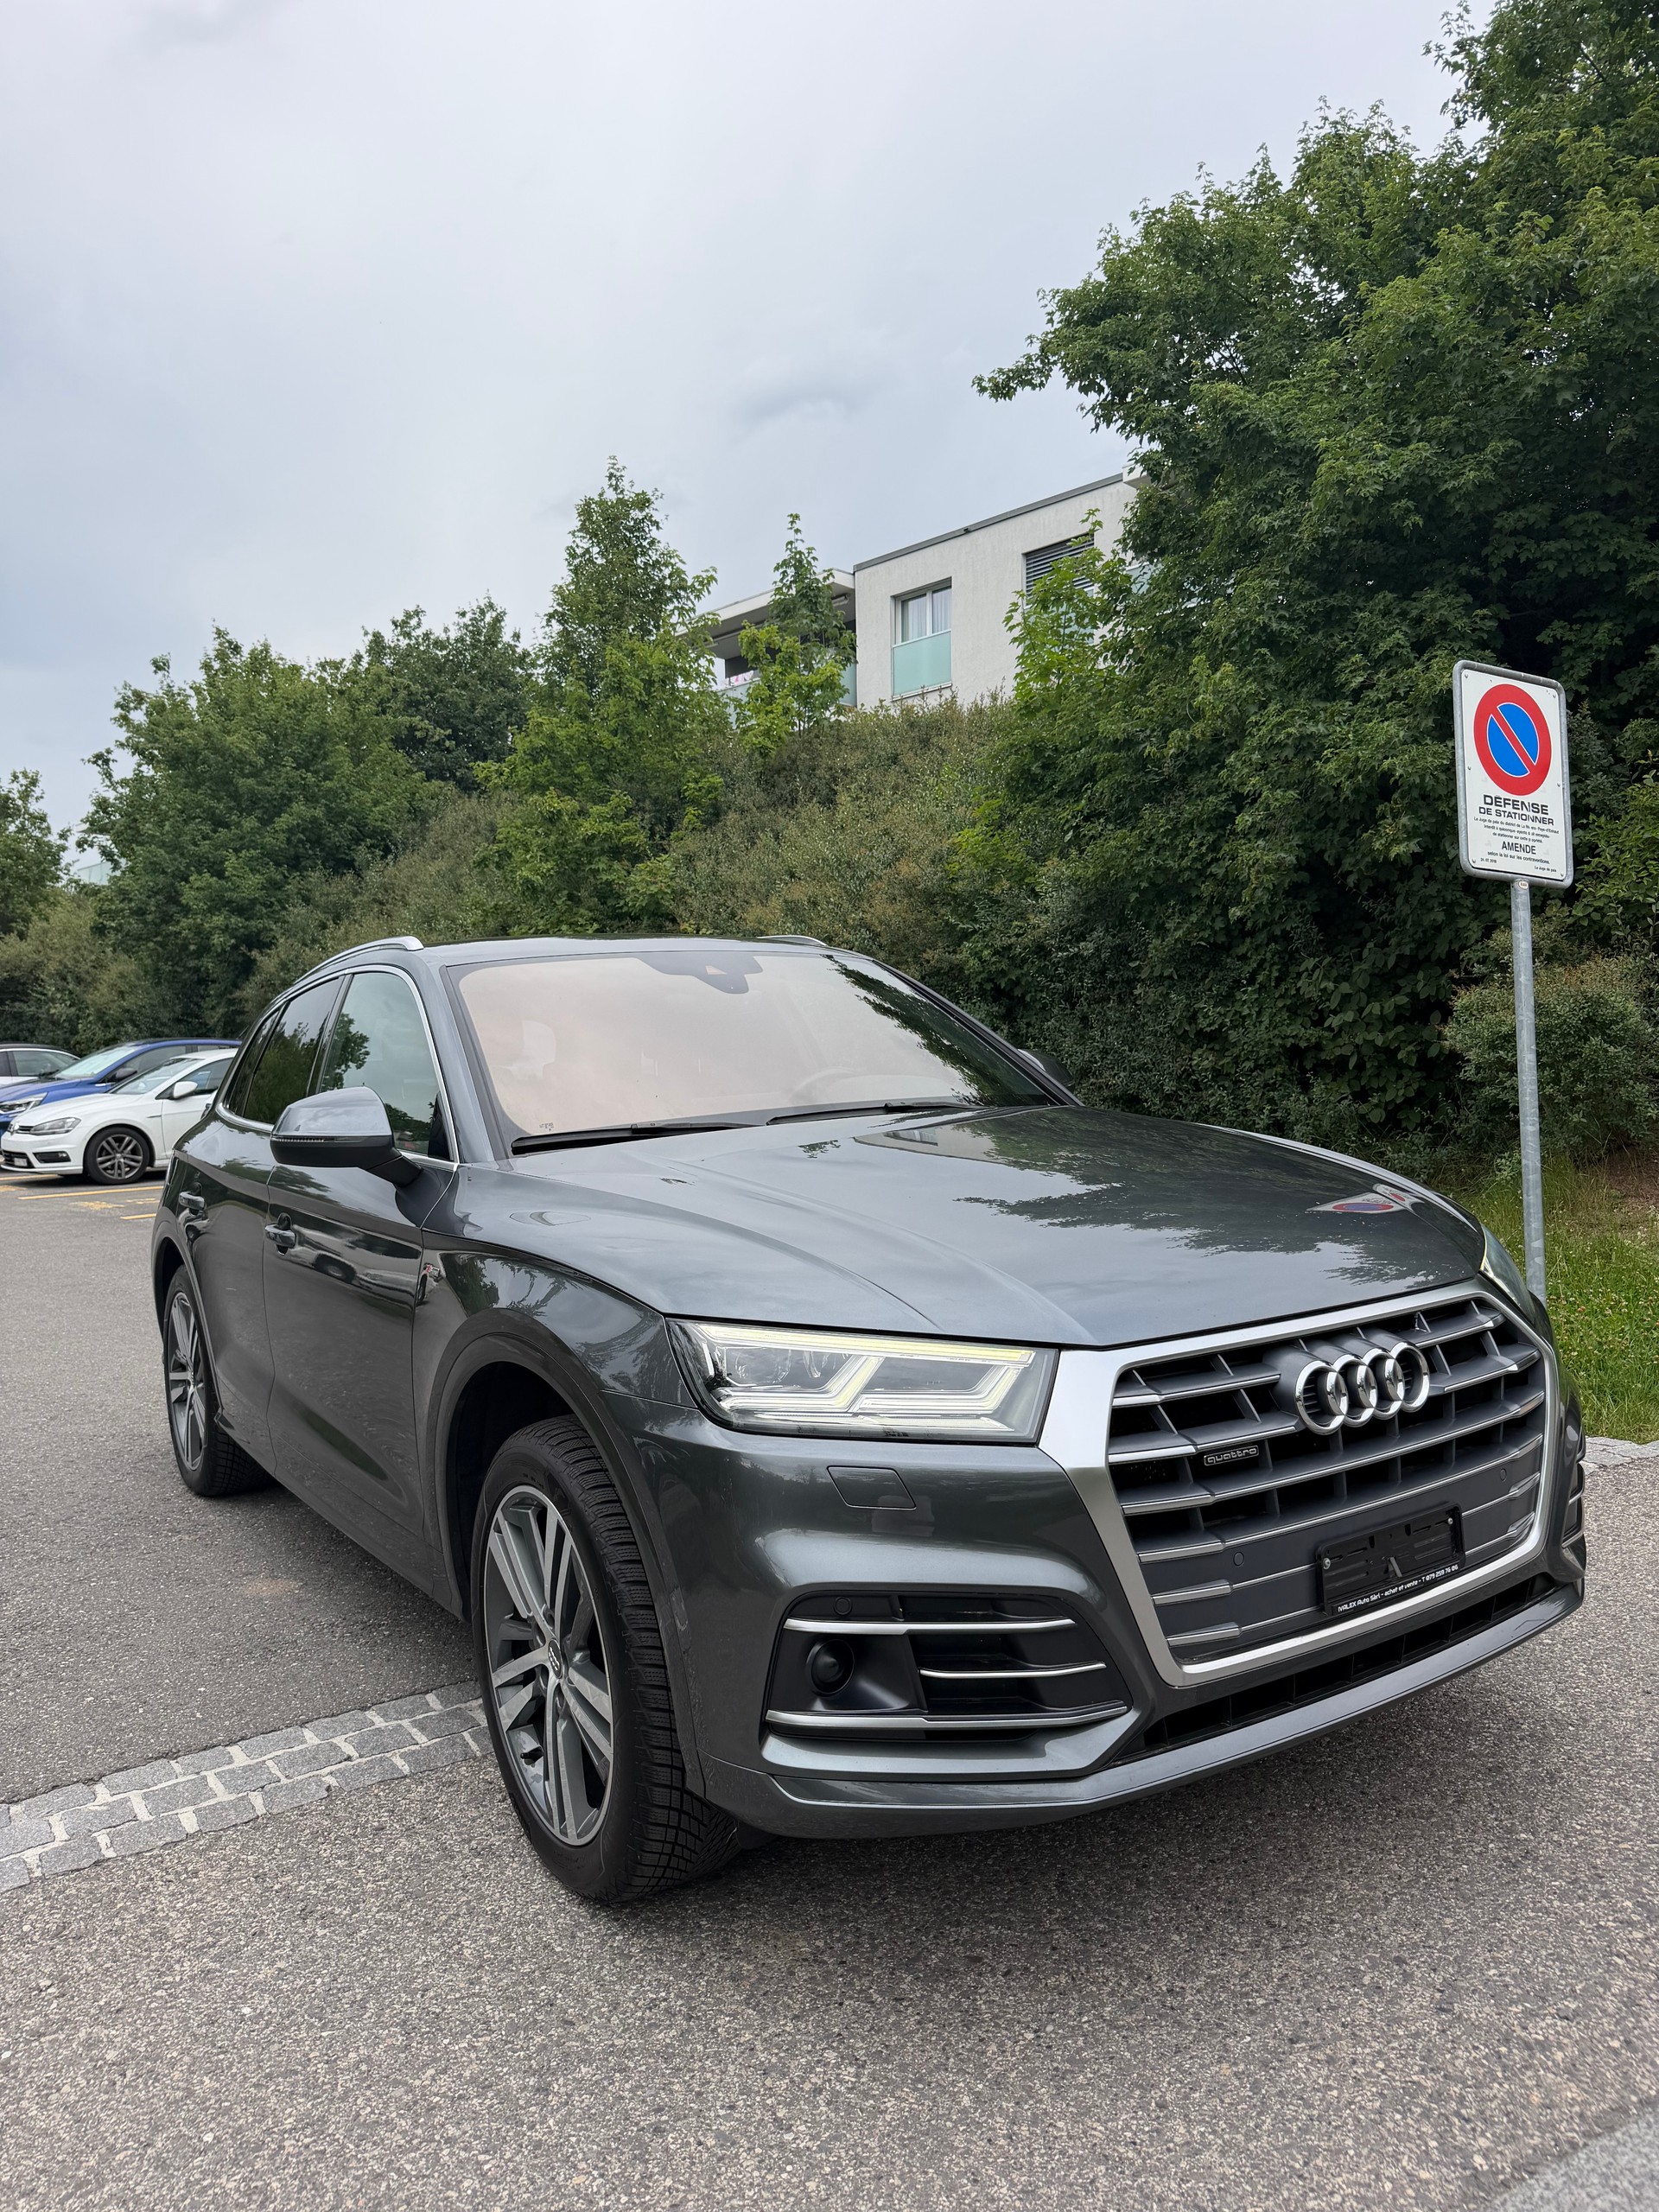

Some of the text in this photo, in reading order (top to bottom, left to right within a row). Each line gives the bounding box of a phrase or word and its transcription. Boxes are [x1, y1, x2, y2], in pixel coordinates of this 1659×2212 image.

[1478, 806, 1554, 826] DE STATIONNER
[1502, 841, 1536, 855] AMENDE
[1207, 1448, 1257, 1464] quattro
[1384, 1586, 1398, 1597] achat
[1404, 1580, 1418, 1589] vente
[1426, 1573, 1435, 1581] 079
[1435, 1569, 1445, 1578] 259
